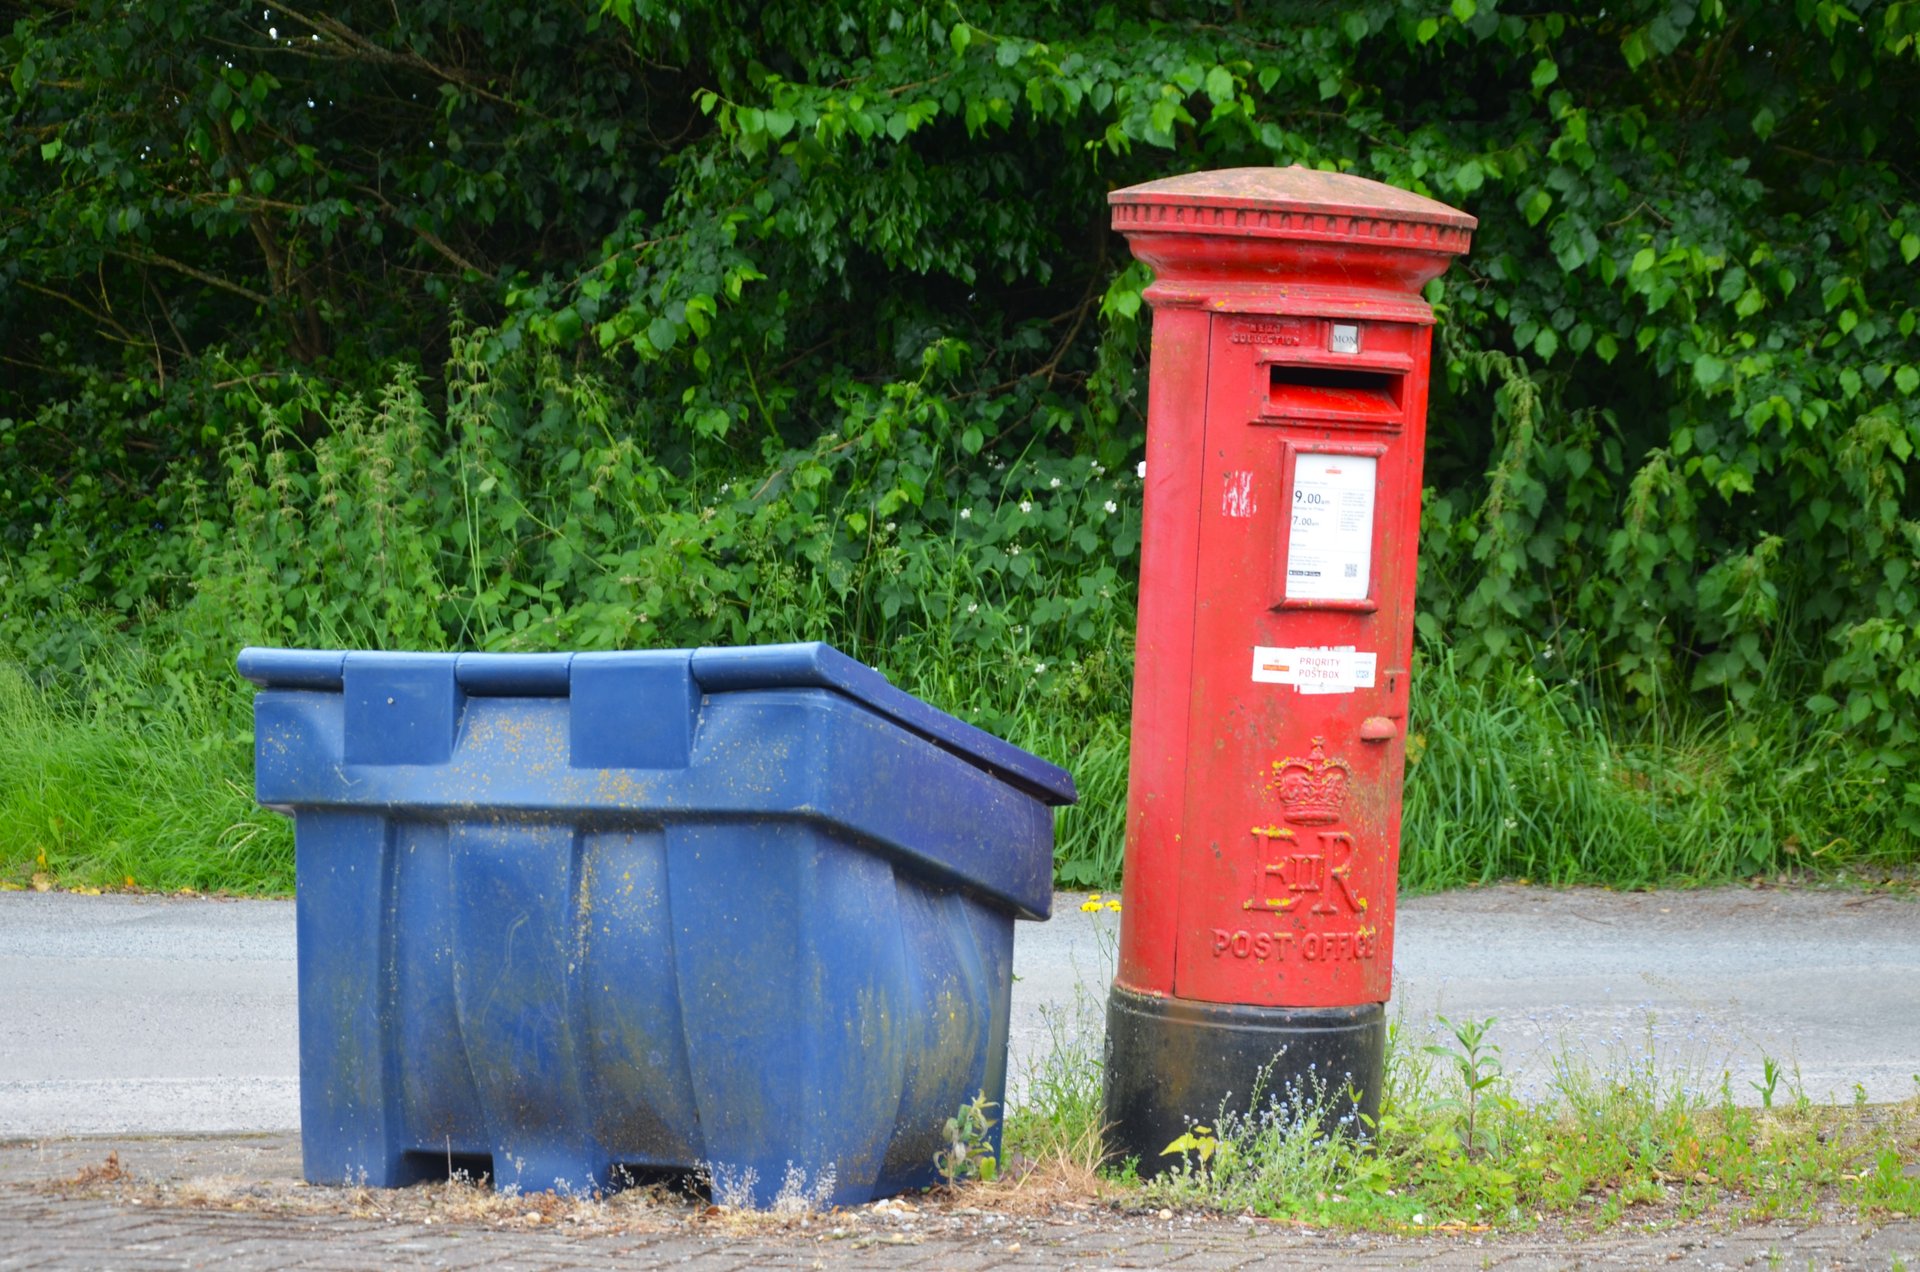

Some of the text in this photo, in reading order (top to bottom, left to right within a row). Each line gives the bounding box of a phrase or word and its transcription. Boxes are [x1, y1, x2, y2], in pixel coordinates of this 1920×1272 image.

[1232, 332, 1300, 347] COLLECTION
[1334, 334, 1357, 345] MON
[1299, 657, 1341, 667] PRIORITY
[1298, 668, 1340, 679] POSTBOX
[1209, 928, 1376, 961] POST OFFICE
